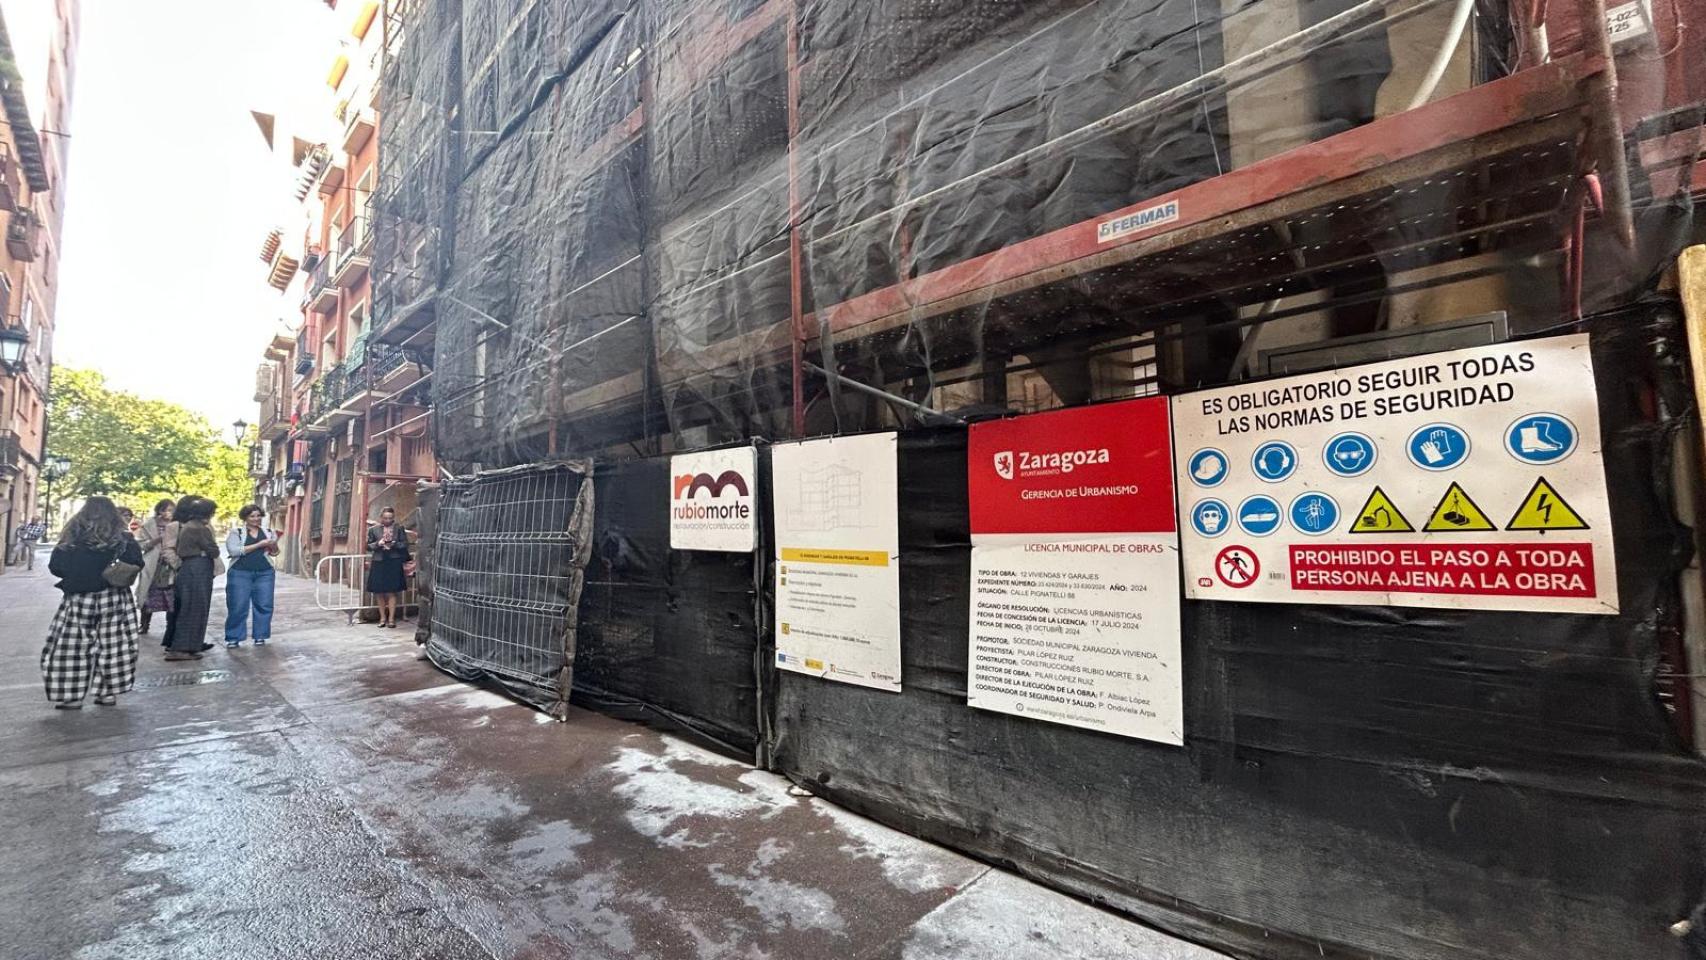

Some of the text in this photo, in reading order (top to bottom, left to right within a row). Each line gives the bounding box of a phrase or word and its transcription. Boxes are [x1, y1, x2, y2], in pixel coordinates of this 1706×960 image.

[1112, 204, 1176, 232] FERMAR
[1202, 352, 1535, 416] ES OBLIGATORIO SEGUIR TODAS
[1218, 381, 1515, 435] LAS NORMAS DE SEGURIDAD
[1019, 448, 1110, 473] Zaragoza
[1020, 469, 1061, 477] AYUNTAMIENTO
[1021, 485, 1139, 500] GERENCIA DE URBANISMO
[674, 500, 750, 520] rubiomorte
[1025, 544, 1163, 553] LICENCIA MUNICIPAL DE OBRAS
[1294, 549, 1584, 568] PROHIBIDO EL PASO A TODA
[1110, 583, 1127, 591] AÑO:
[1296, 570, 1587, 591] PERSONA AJENA A LA OBRA
[1030, 591, 1065, 599] PIGNATELLI
[1004, 614, 1037, 622] CONCESIÓN
[1058, 618, 1087, 626] LICENCIA:
[1011, 605, 1049, 613] RESOLUCIÓN:
[1054, 608, 1088, 616] LICENCIAS
[1090, 609, 1142, 620] URBANÍSTICAS
[1033, 625, 1062, 633] OCTUBRE
[1013, 637, 1044, 647] SOCIEDAD
[1046, 641, 1080, 651] MUNICIPAL
[1082, 645, 1120, 655] ZARAGOZA
[1122, 650, 1157, 659] VIVIENDA
[1018, 649, 1035, 657] PILAR
[1037, 650, 1057, 660] LÓPEZ
[976, 664, 1002, 673] DIRECTOR
[1013, 669, 1031, 677] OBRA:
[1035, 671, 1053, 679] PILAR
[1078, 677, 1094, 686] RUIZ
[1021, 659, 1080, 672] CONSTRUCCIONES
[1082, 667, 1104, 676] RUBIO
[976, 674, 1002, 683] DIRECTOR
[1022, 680, 1055, 691] EJECUCIÓN
[1077, 689, 1098, 698] OBRA:
[1130, 696, 1150, 706] López
[976, 684, 1018, 695] COORDINADOR
[1029, 691, 1065, 703] SEGURIDAD
[1072, 699, 1097, 709] SALUD:
[1139, 709, 1157, 718] Arpa
